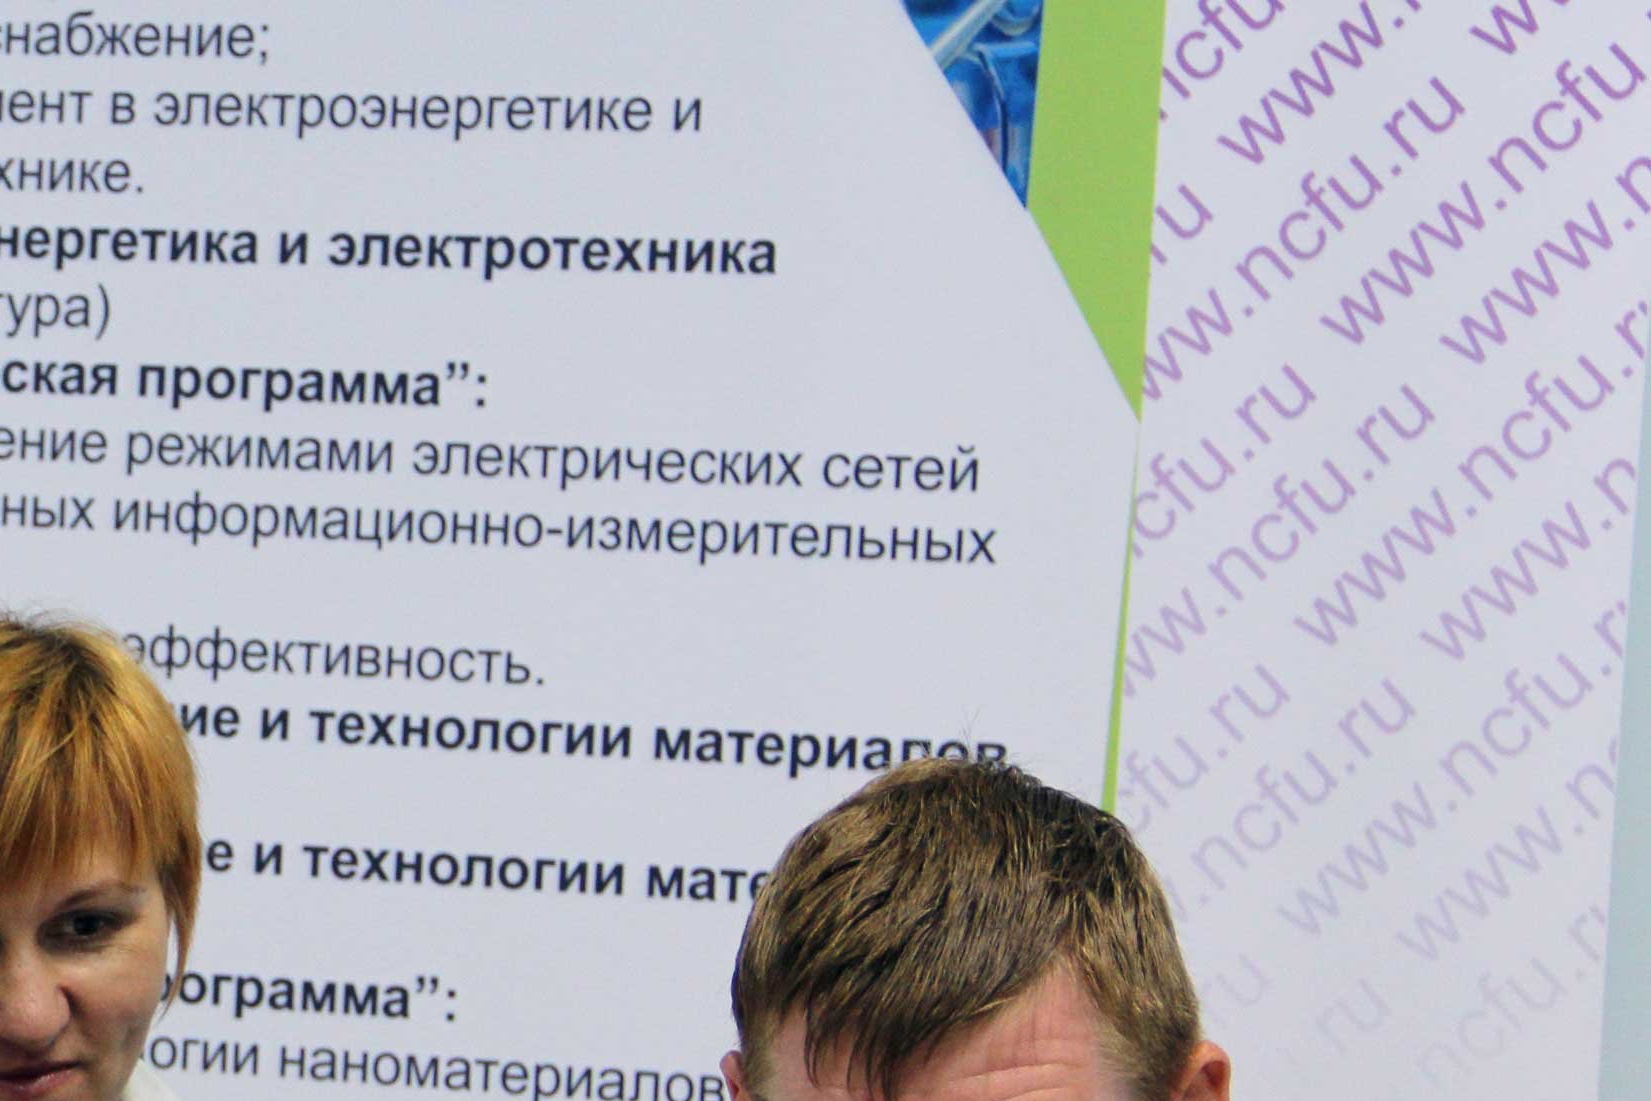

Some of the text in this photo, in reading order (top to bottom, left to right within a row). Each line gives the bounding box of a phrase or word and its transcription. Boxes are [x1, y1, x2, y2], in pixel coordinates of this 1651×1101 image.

[110, 91, 136, 125] в
[153, 91, 653, 142] электроэнергетике
[673, 98, 702, 132] и
[279, 232, 308, 265] и
[328, 232, 776, 281] электротехника
[1141, 76, 1467, 401] ww.ncfu.ru
[138, 362, 487, 412] программа”:
[126, 431, 393, 476] режимами
[412, 441, 802, 492] электрических
[822, 445, 979, 492] сетей
[1133, 362, 1317, 558] cfu.ru
[1293, 300, 1648, 647] www.ncfu.r
[113, 490, 996, 566] информационно-измерительных
[1123, 384, 1436, 699] ww.ncfu.ru
[260, 708, 290, 741] и
[308, 710, 631, 759] технологии
[254, 842, 283, 876] и
[302, 845, 624, 896] технологии
[142, 1035, 259, 1077] огии
